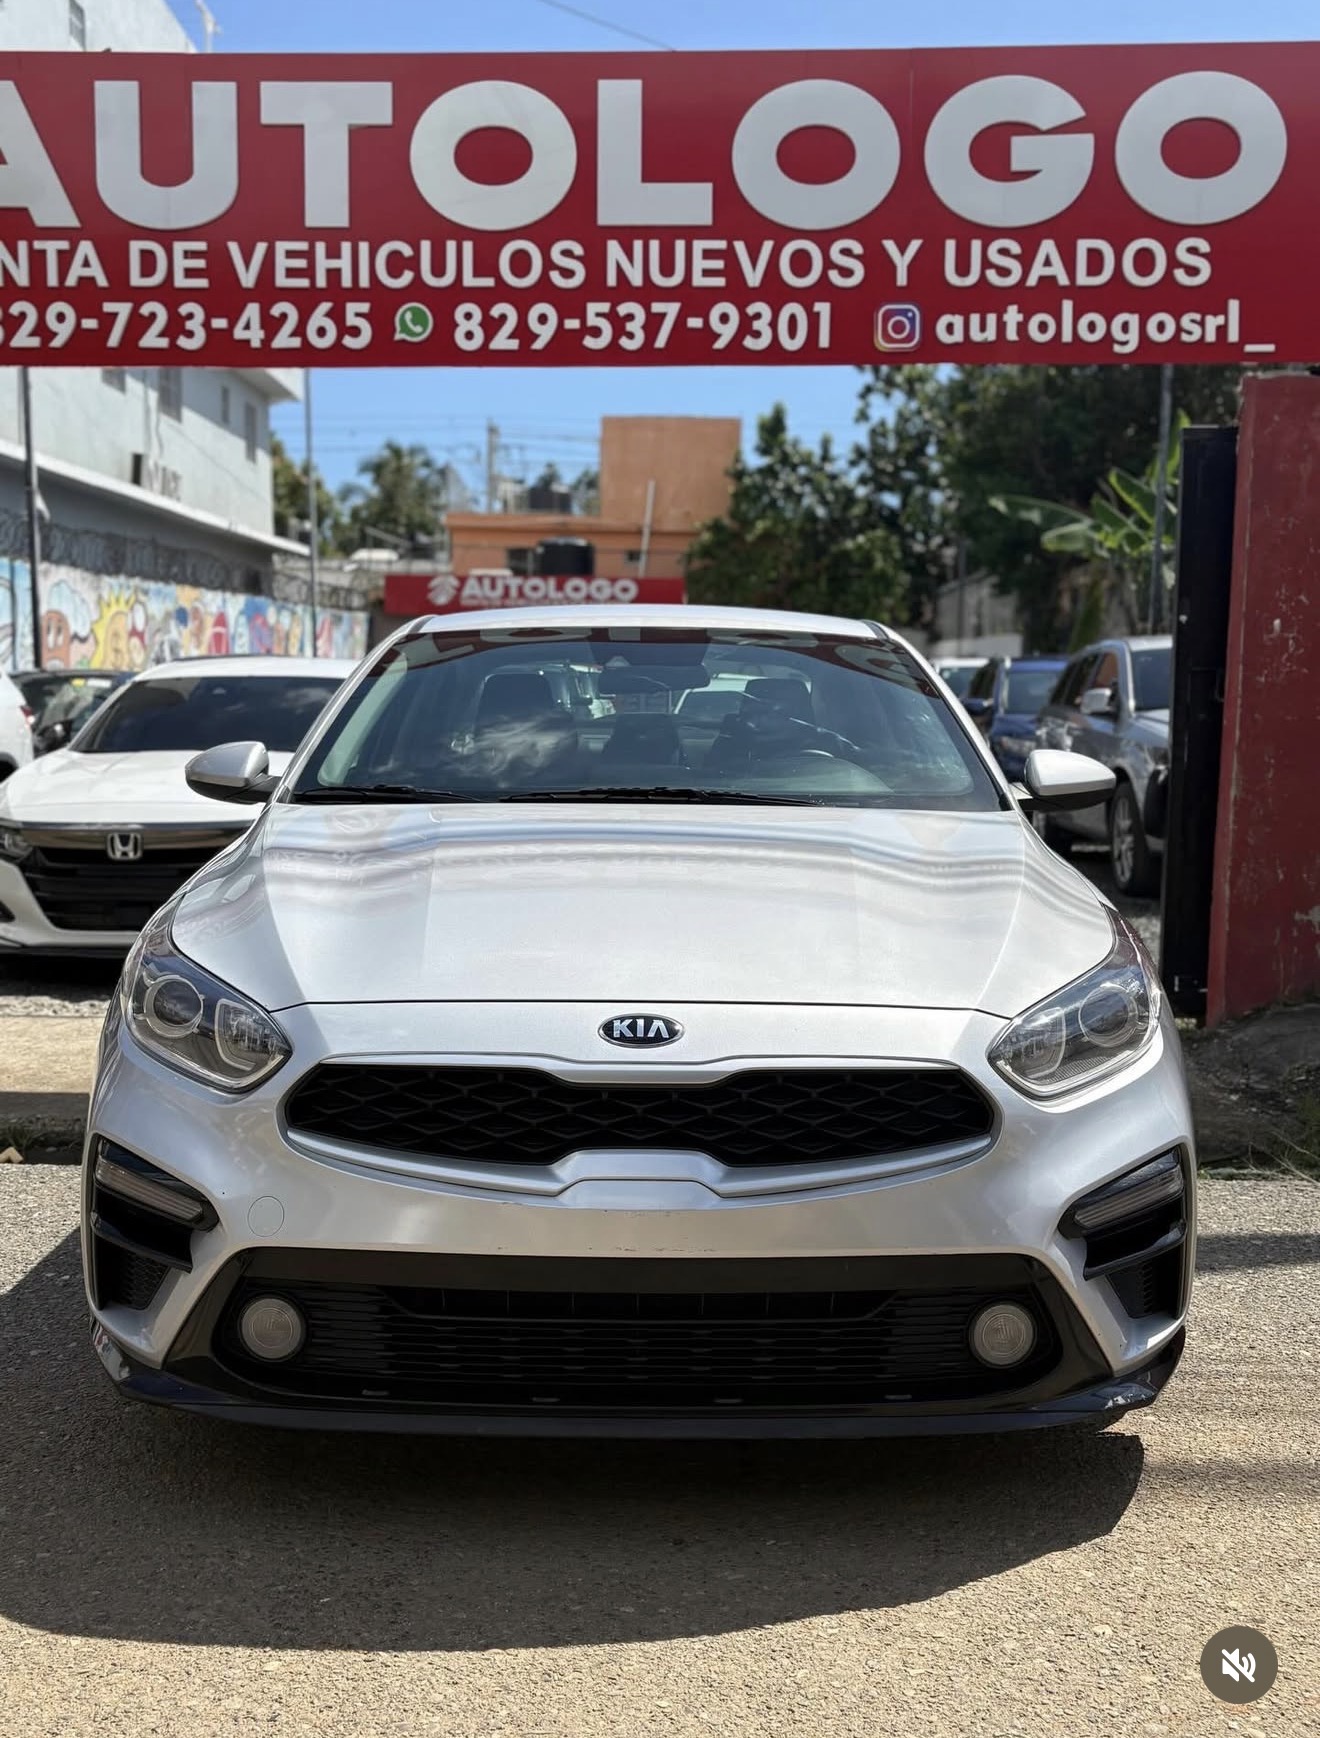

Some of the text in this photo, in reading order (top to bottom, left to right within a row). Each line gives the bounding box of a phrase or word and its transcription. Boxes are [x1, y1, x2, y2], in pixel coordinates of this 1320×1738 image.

[0, 71, 1288, 231] AUTOLOGO
[129, 240, 210, 289] DE
[227, 239, 586, 289] VEHICULOS
[606, 238, 866, 288] NUEVOS
[882, 238, 924, 287] Y
[943, 237, 1212, 288] USADOS
[0, 299, 1276, 354] 29-723-4265 829-537-9301 autologosrl_
[461, 576, 639, 601] AUTOLOGO
[612, 1018, 670, 1038] KIA
